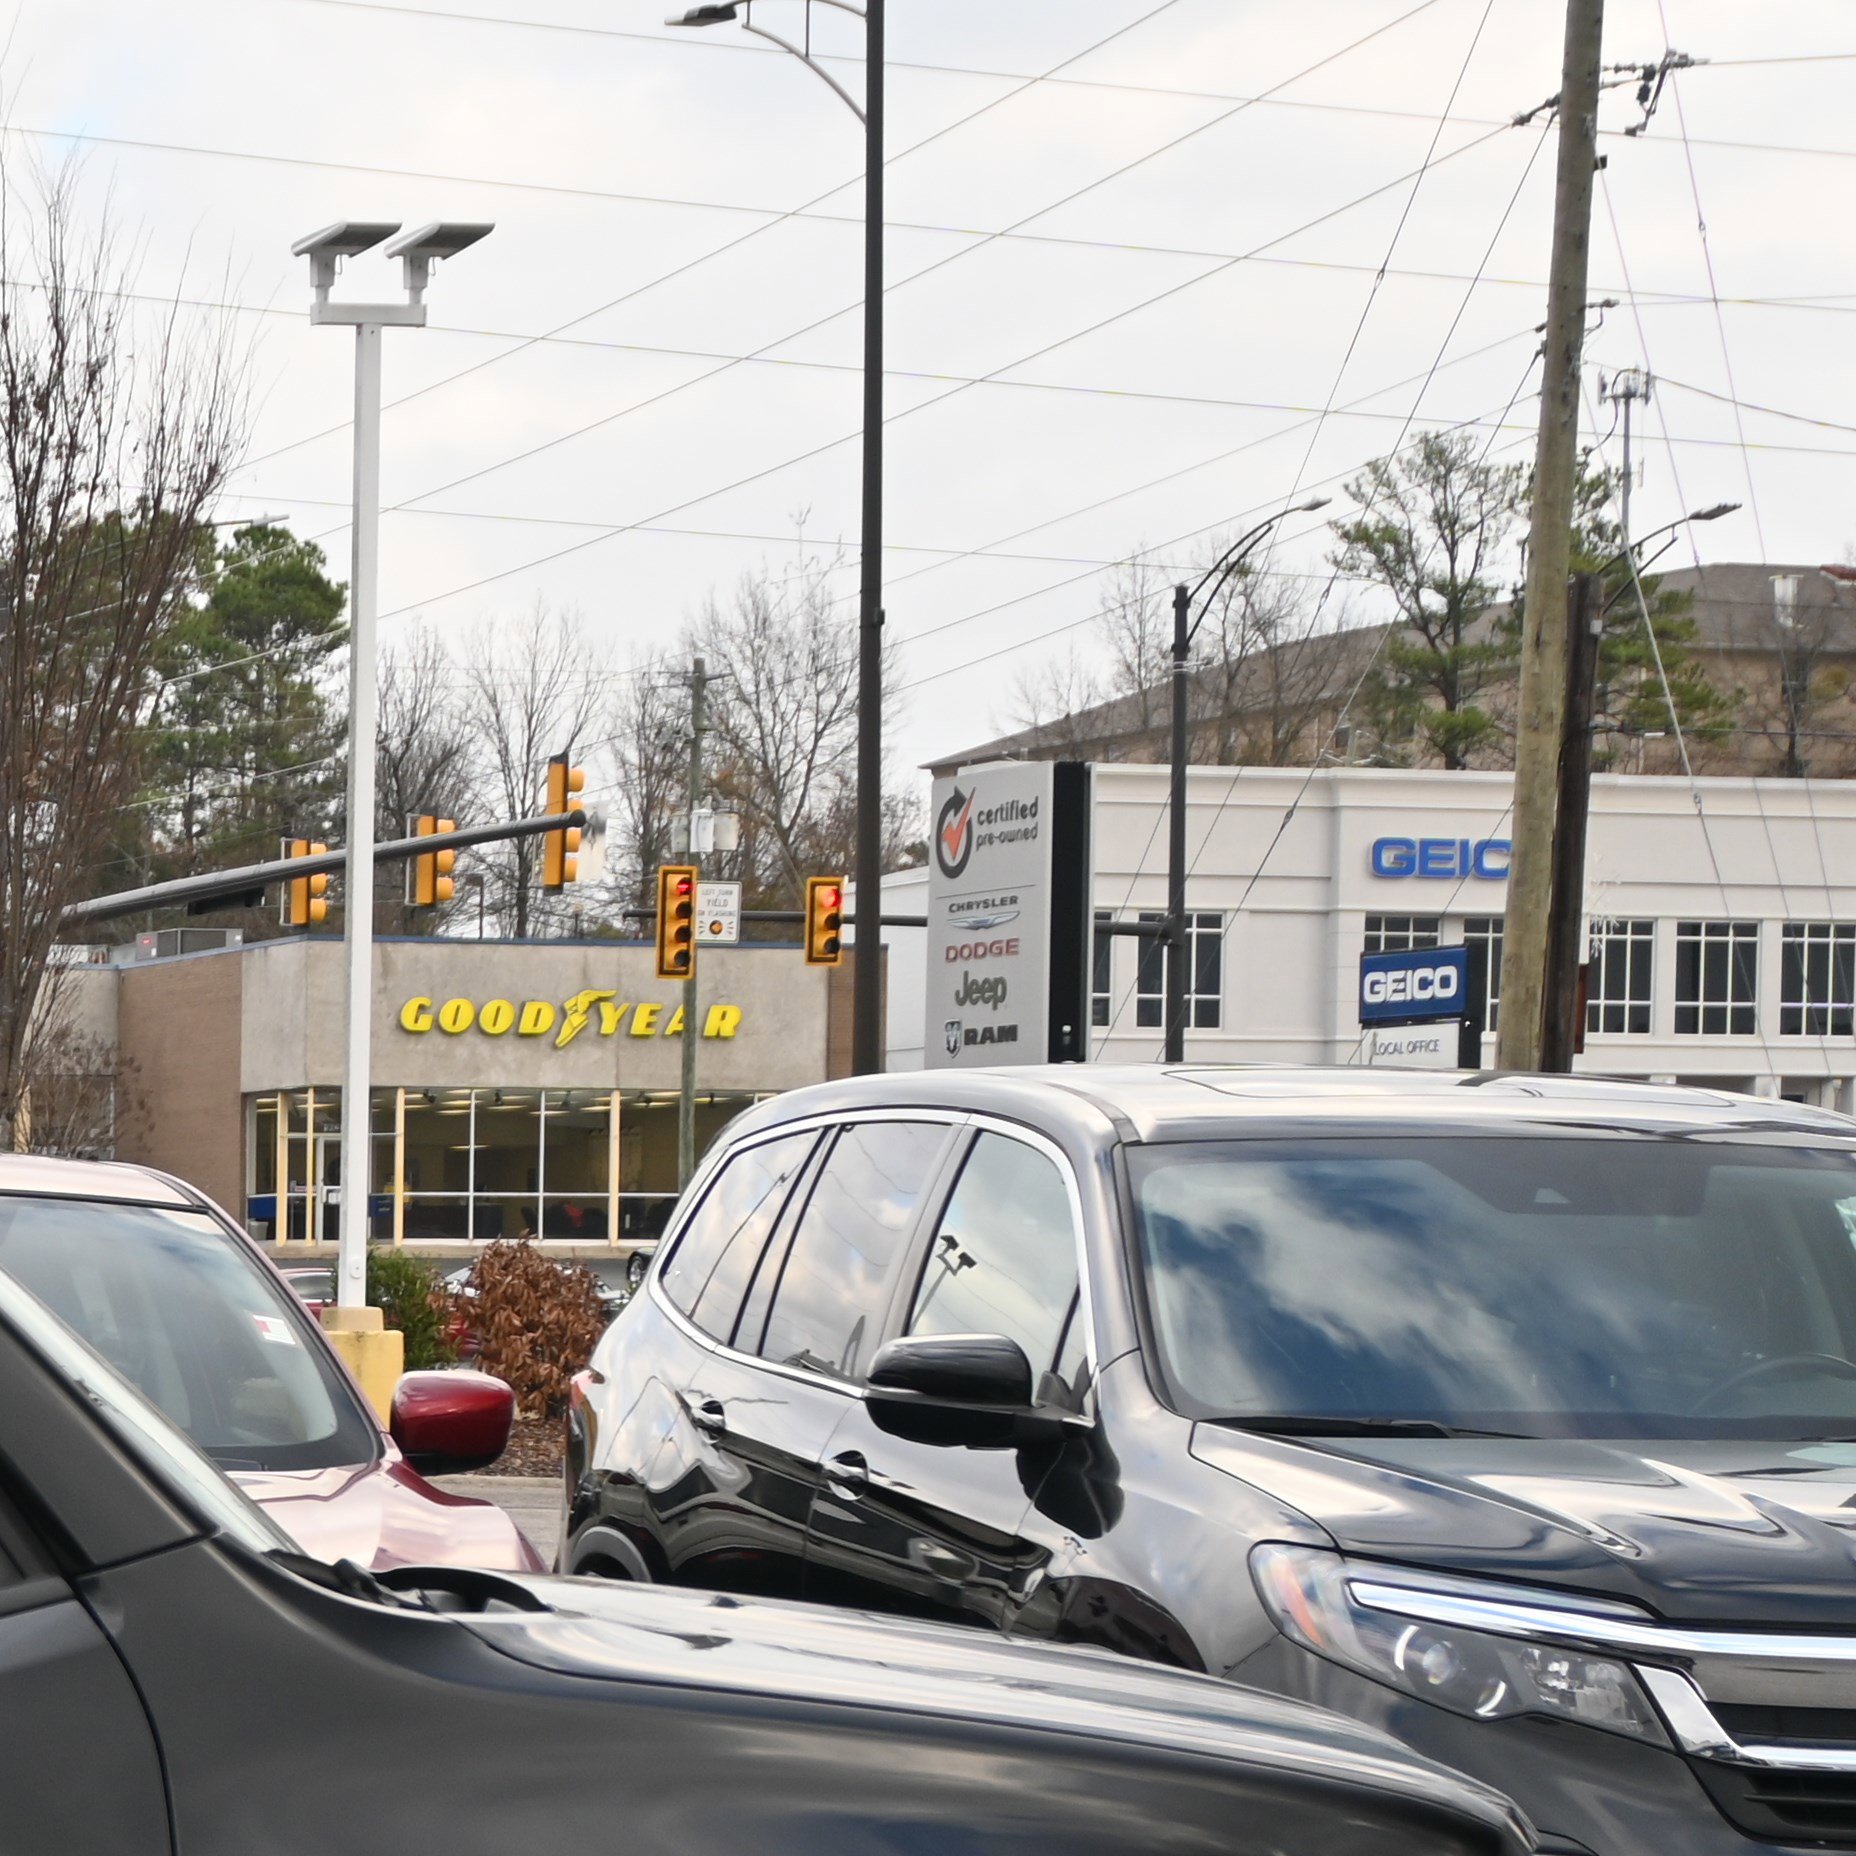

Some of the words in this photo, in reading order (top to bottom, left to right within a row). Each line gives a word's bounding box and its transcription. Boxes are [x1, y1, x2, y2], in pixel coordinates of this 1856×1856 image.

[977, 796, 1039, 826] certified
[976, 821, 1039, 851] pre-owned
[1371, 837, 1512, 878] GEIC
[948, 895, 1019, 914] CHRYSLER
[945, 937, 1020, 964] DODGE
[955, 970, 1007, 1011] Jeep
[1363, 965, 1458, 1004] GEICO
[964, 1024, 1019, 1046] RAM
[1374, 1041, 1405, 1056] LOCAL
[1407, 1039, 1440, 1054] OFFICE
